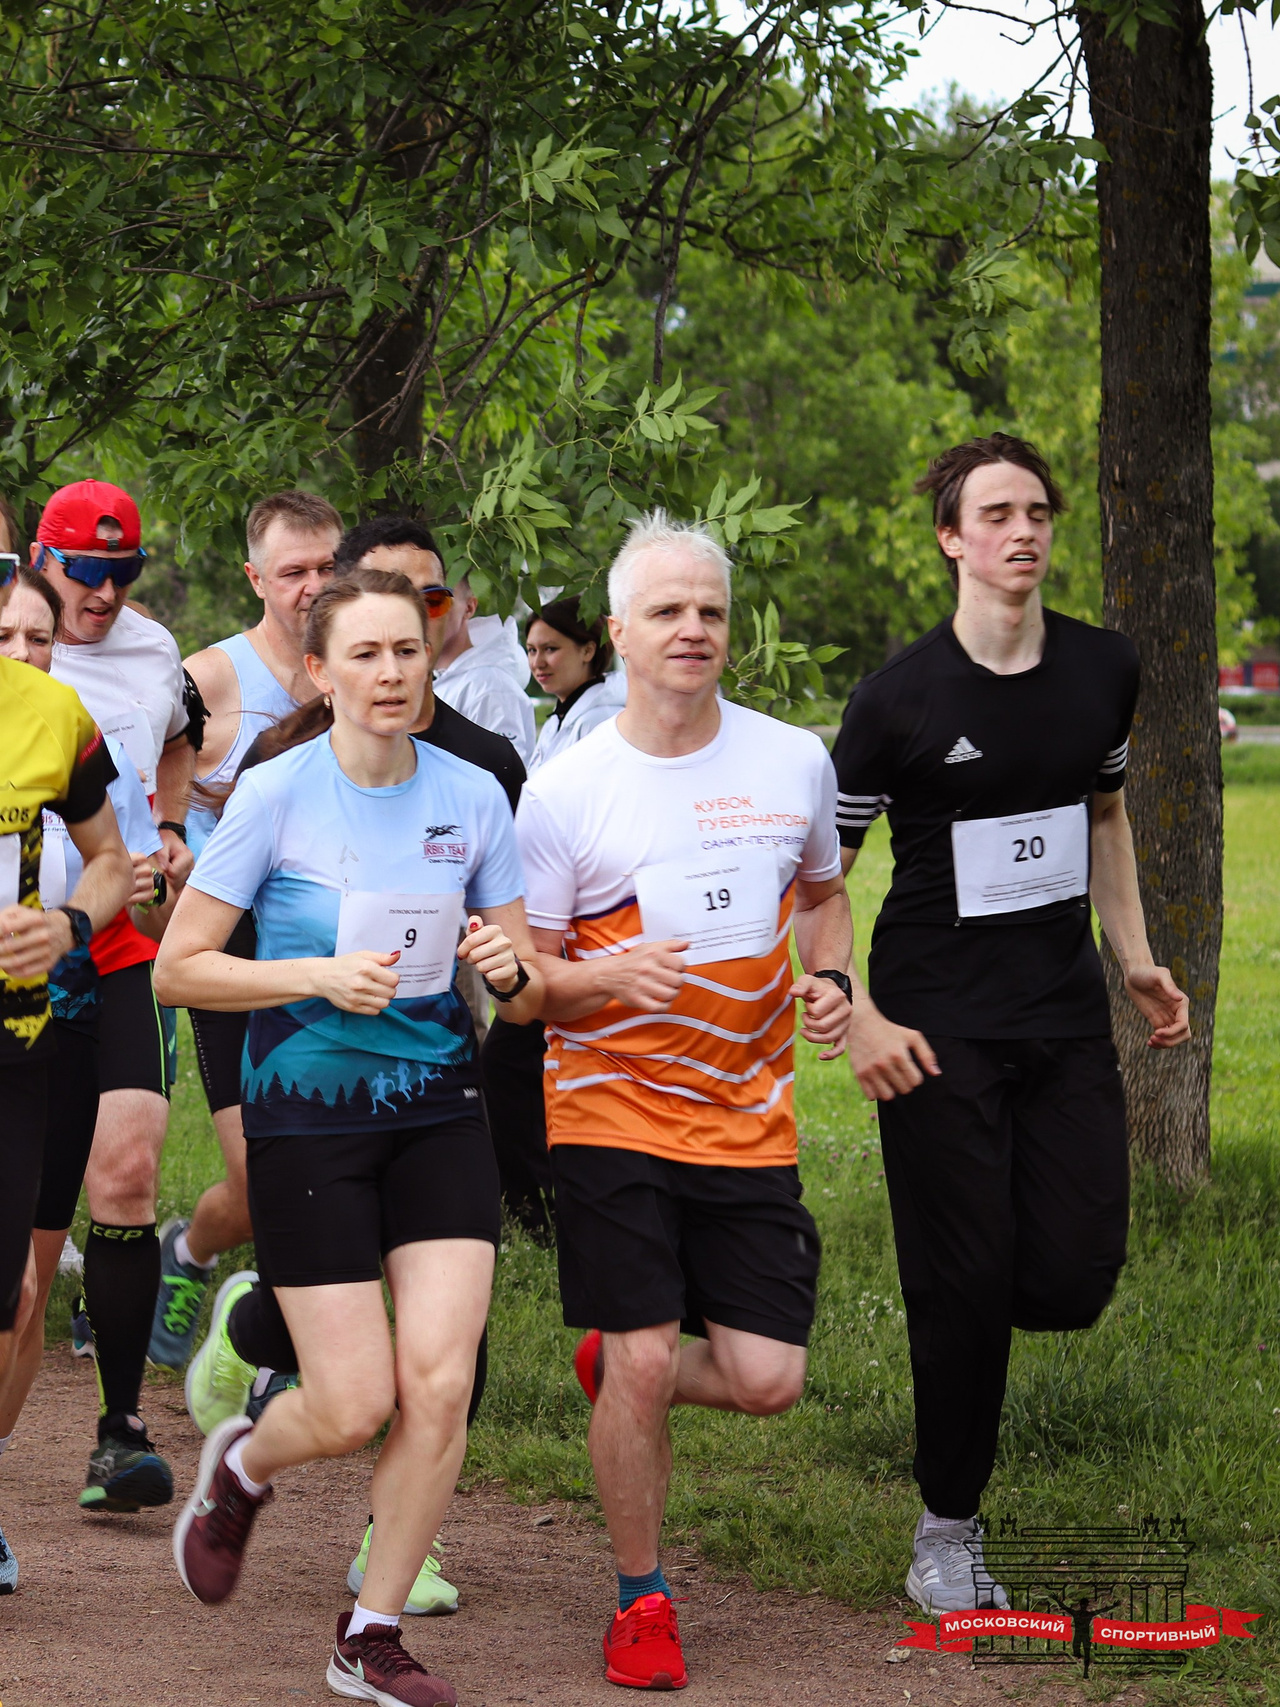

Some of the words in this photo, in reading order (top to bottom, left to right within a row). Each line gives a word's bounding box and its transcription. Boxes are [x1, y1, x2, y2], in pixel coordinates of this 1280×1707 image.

[693, 796, 755, 813] КУБОК
[1012, 836, 1045, 863] 20
[703, 888, 732, 911] 19
[404, 928, 417, 949] 9
[92, 1225, 144, 1241] cep
